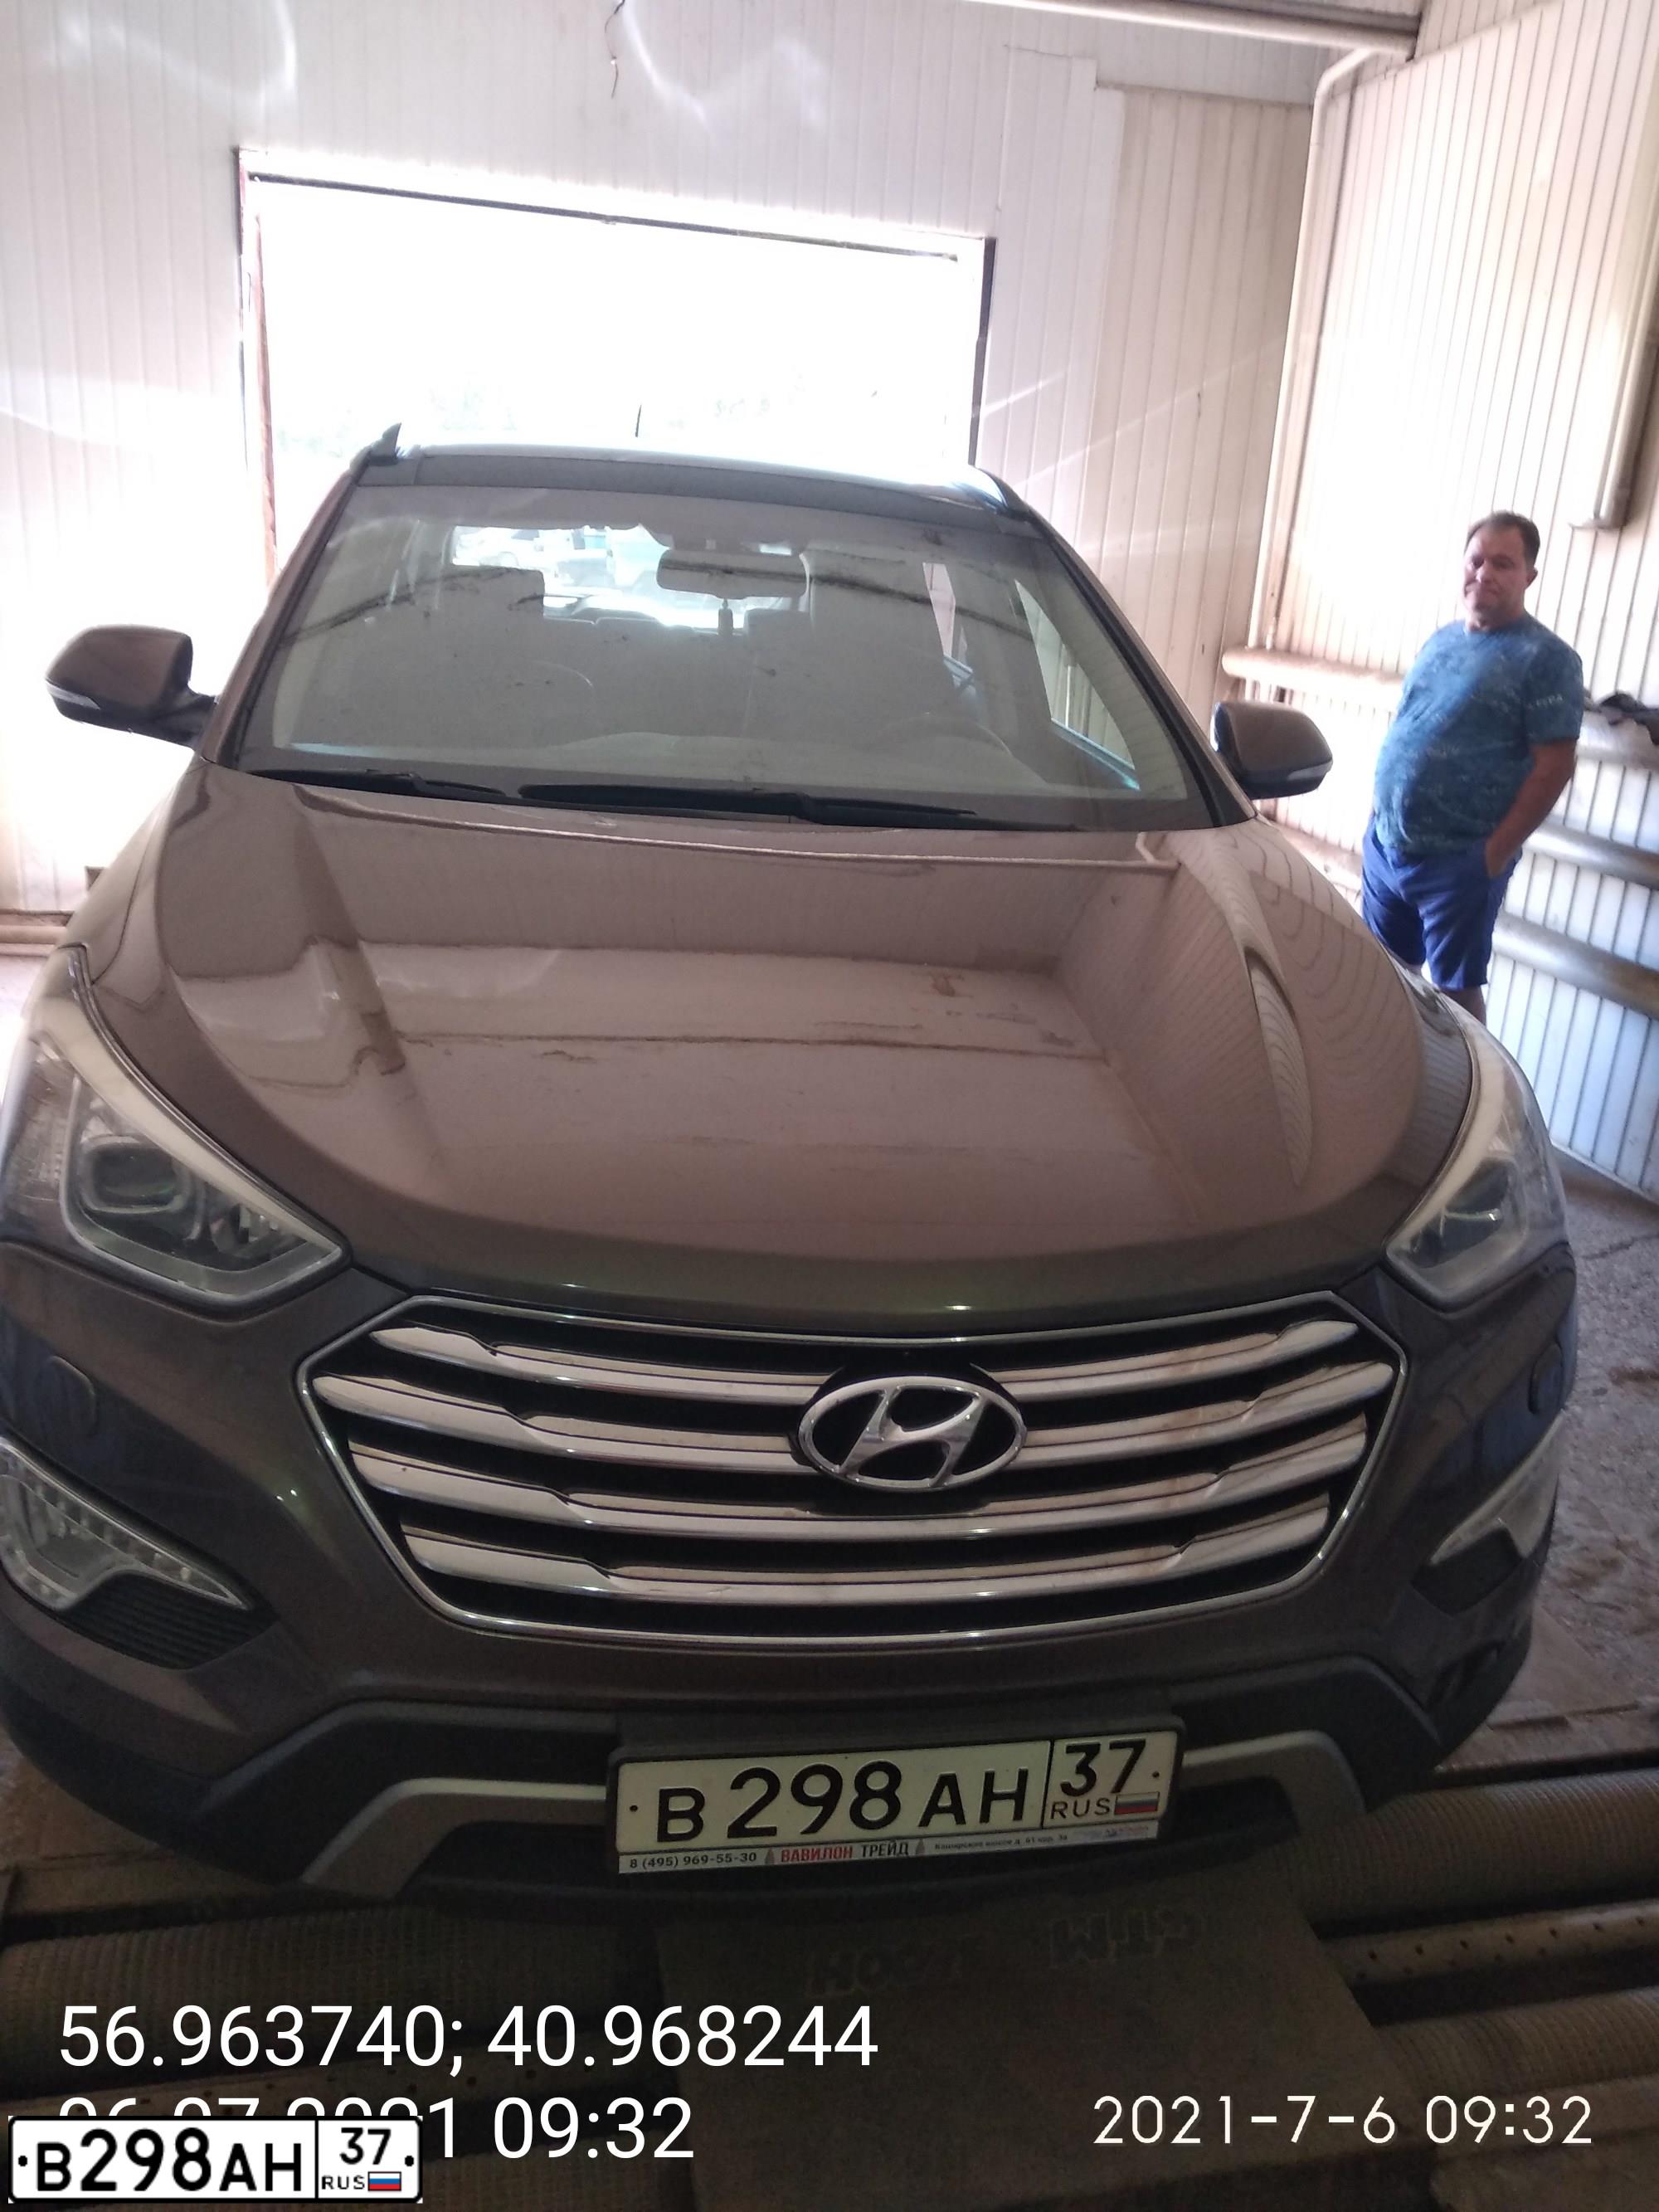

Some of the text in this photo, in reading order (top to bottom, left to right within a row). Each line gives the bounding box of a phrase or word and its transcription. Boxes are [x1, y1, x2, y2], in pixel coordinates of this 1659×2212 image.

[1059, 1738, 1146, 1797] 37
[1049, 1797, 1111, 1820] RUS
[629, 1839, 910, 1870] 8 (495) 969-55-30 ВАВИЛОН ТРЕЙД
